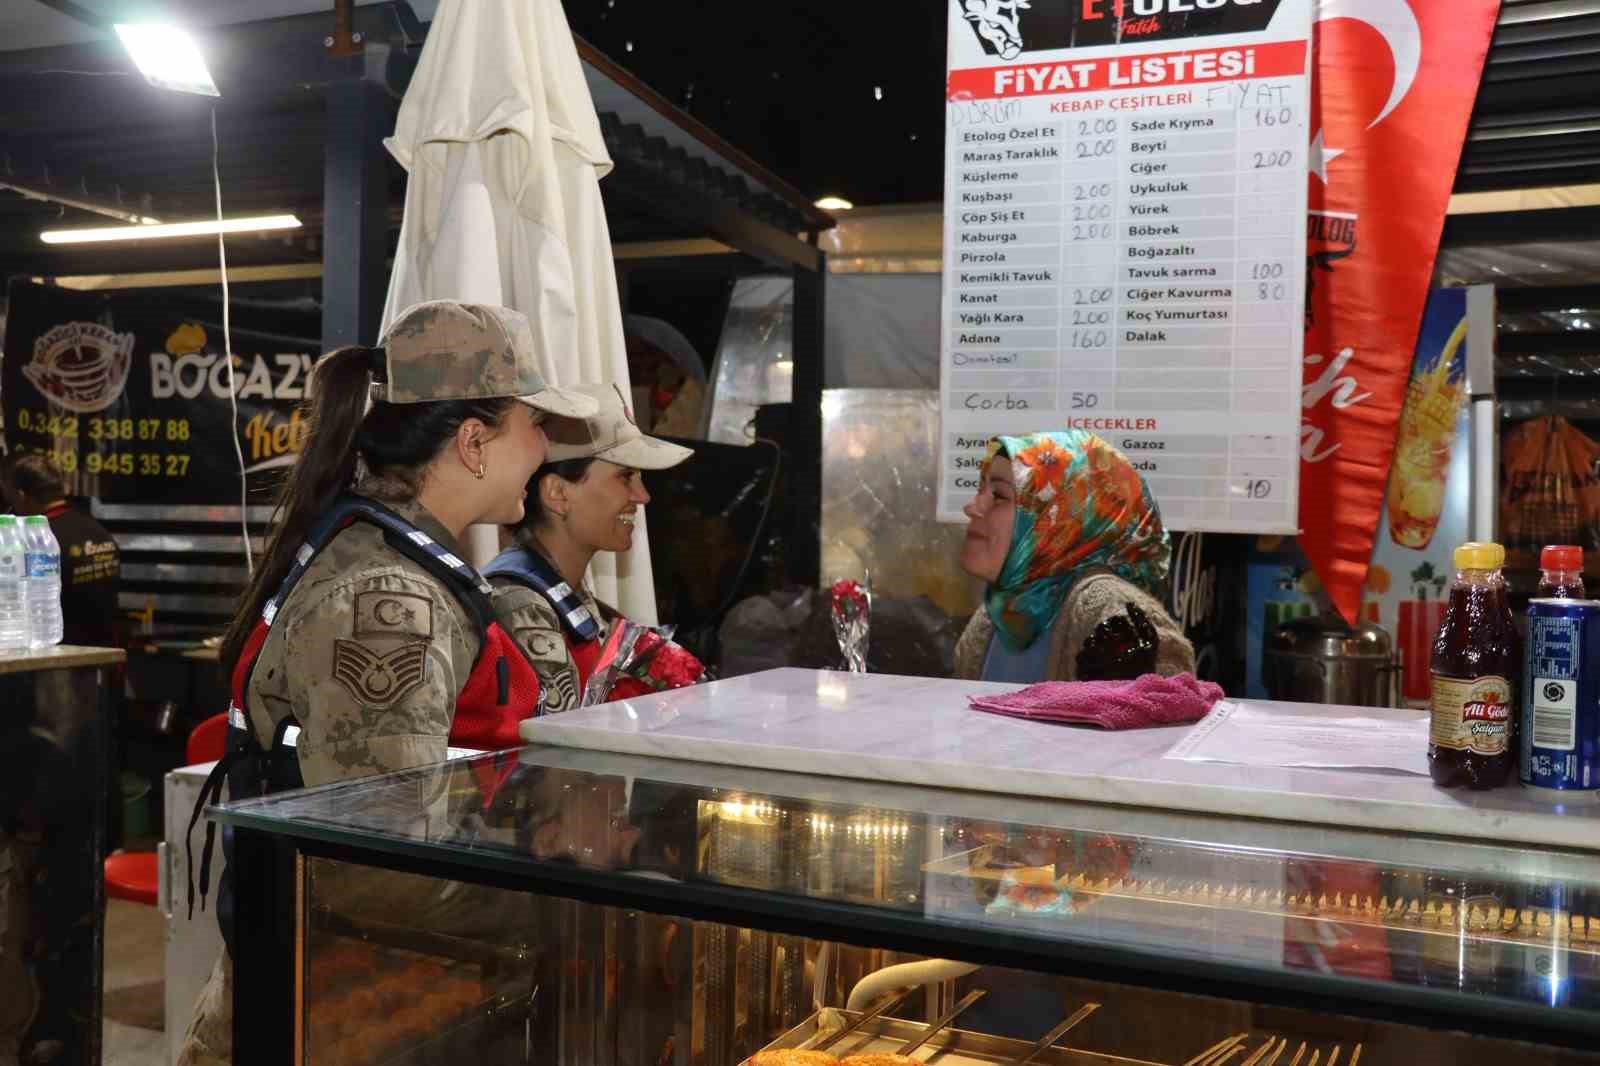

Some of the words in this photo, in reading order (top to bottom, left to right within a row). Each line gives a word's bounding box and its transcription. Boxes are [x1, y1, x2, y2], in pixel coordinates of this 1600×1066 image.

[1119, 16, 1161, 35] Fatih
[1050, 100, 1104, 113] KEBAP
[1109, 92, 1192, 111] ÇEŞİTLERİ
[1255, 107, 1292, 127] 160
[1078, 119, 1117, 136] 200
[1131, 120, 1166, 132] Sade
[1169, 118, 1214, 129] Kıyma
[963, 131, 1006, 143] Etolog
[1009, 127, 1038, 140] Özel
[1042, 128, 1056, 137] Et
[1076, 139, 1115, 159] 200
[1131, 140, 1167, 153] Beyti
[963, 152, 1002, 164] Maraş
[1005, 147, 1058, 160] Taraklık
[1253, 151, 1292, 169] 200
[1130, 162, 1168, 175] Ciğer
[963, 170, 1019, 183] Küşleme
[1074, 183, 1111, 201] 200
[1130, 182, 1188, 196] Uykuluk
[962, 191, 1013, 204] Kuşbaşı
[991, 210, 1008, 223] Şiş
[1012, 211, 1025, 221] Et
[1073, 204, 1111, 222] 200
[1129, 204, 1169, 215] Yürek
[961, 231, 1017, 244] Kaburga
[1129, 225, 1180, 237] Böbrek
[961, 252, 1006, 263] Pirzola
[1128, 245, 1195, 259] Boğazaltı
[960, 271, 1009, 283] Kemikli
[1012, 270, 1052, 281] Tavuk
[1128, 267, 1169, 278] Tavuk
[1172, 267, 1217, 277] sarma
[1252, 263, 1283, 280] 100
[1074, 288, 1112, 305] 200
[1127, 288, 1164, 301] Ciğer
[1168, 287, 1232, 298] Kavurma
[1258, 282, 1285, 300] 80
[960, 293, 998, 304] Kanat
[959, 313, 991, 325] Yağlı
[993, 312, 1024, 323] Kara
[1072, 309, 1110, 326] 200
[1126, 310, 1152, 322] Koç
[1155, 309, 1228, 320] Yumurtası
[959, 334, 1001, 344] Adana
[1072, 330, 1106, 348] 160
[1126, 330, 1167, 342] Dalak
[1071, 392, 1099, 409] 50
[88, 418, 133, 440] 338
[139, 419, 161, 440] 87
[166, 419, 190, 441] 88
[1122, 439, 1165, 449] Gazoz
[86, 452, 134, 475] 945
[140, 453, 161, 476] 35
[166, 454, 191, 476] 27
[1464, 703, 1486, 717] Ali
